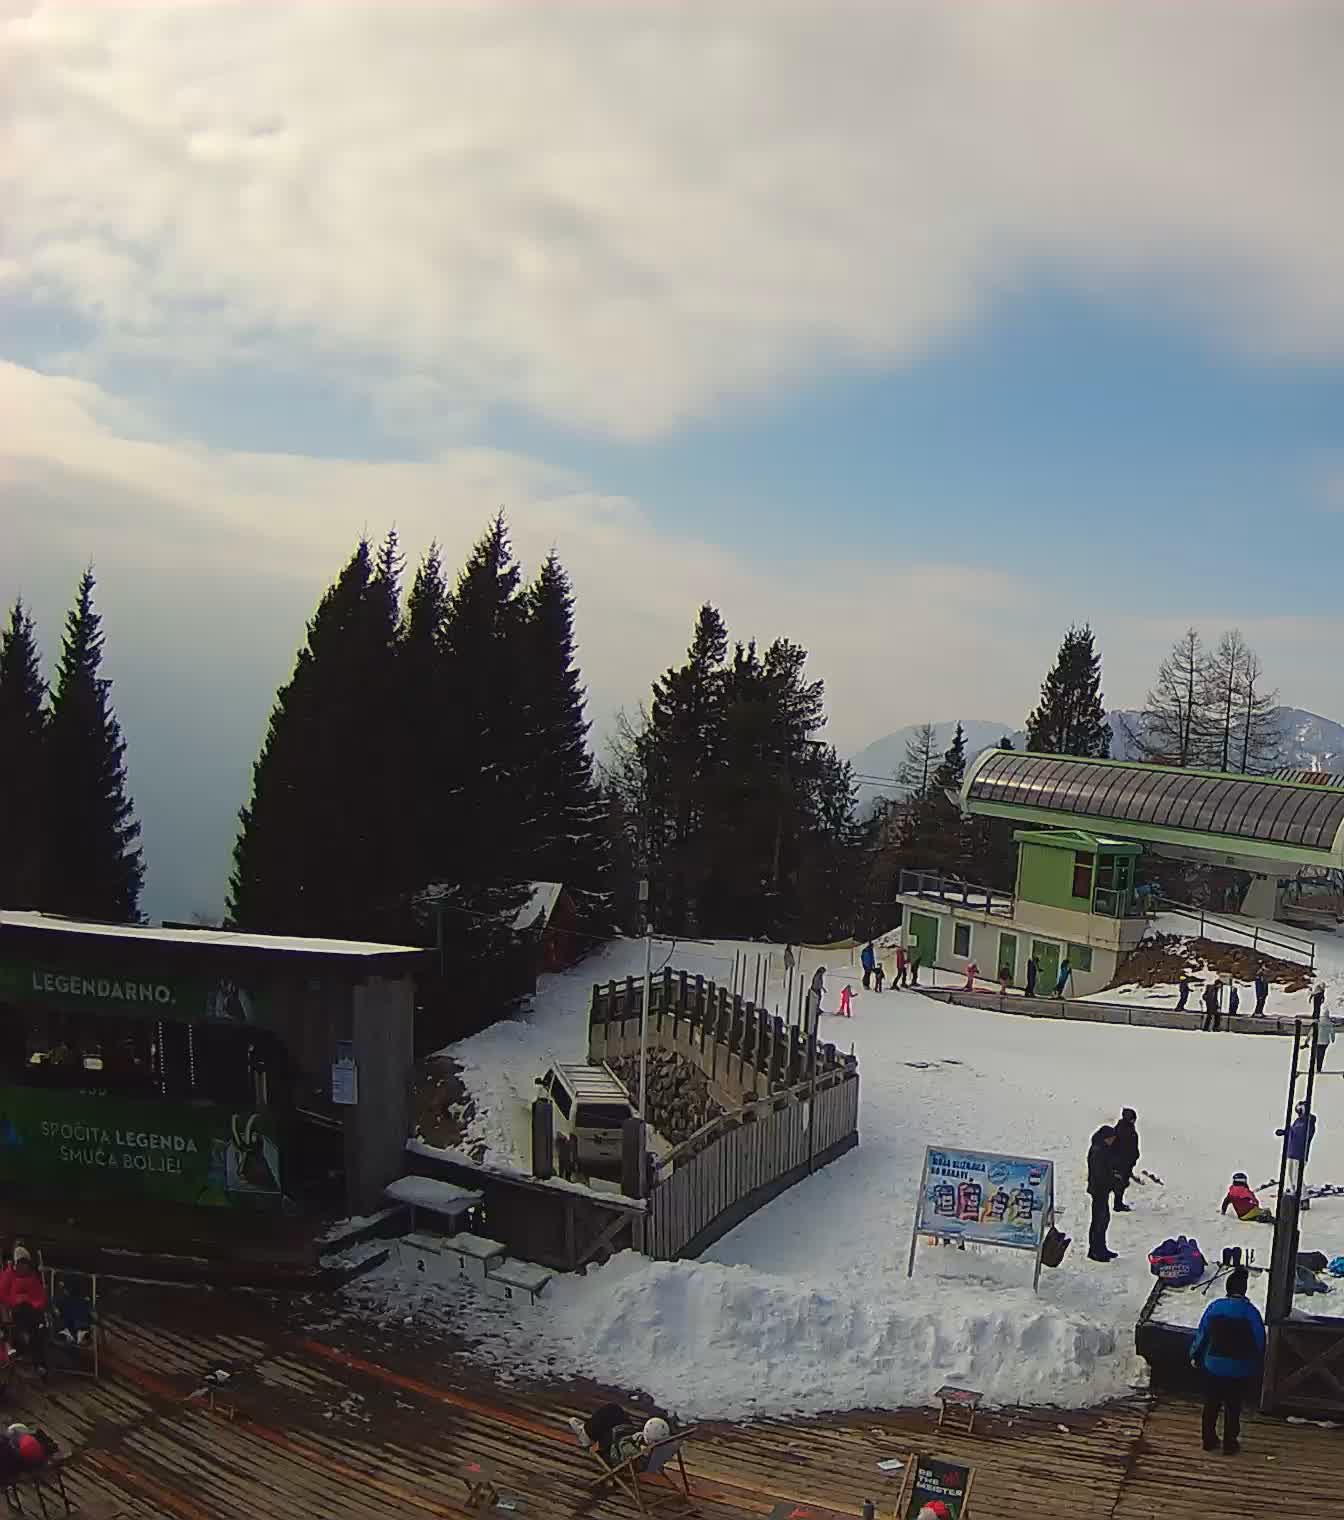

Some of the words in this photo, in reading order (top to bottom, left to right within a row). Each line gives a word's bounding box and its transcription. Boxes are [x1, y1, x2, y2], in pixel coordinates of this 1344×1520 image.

[115, 1128, 198, 1152] LEGENDA
[417, 1259, 425, 1272] 2
[459, 1256, 465, 1268] 1
[504, 1287, 513, 1299] 3
[916, 1481, 963, 1497] MEISTER
